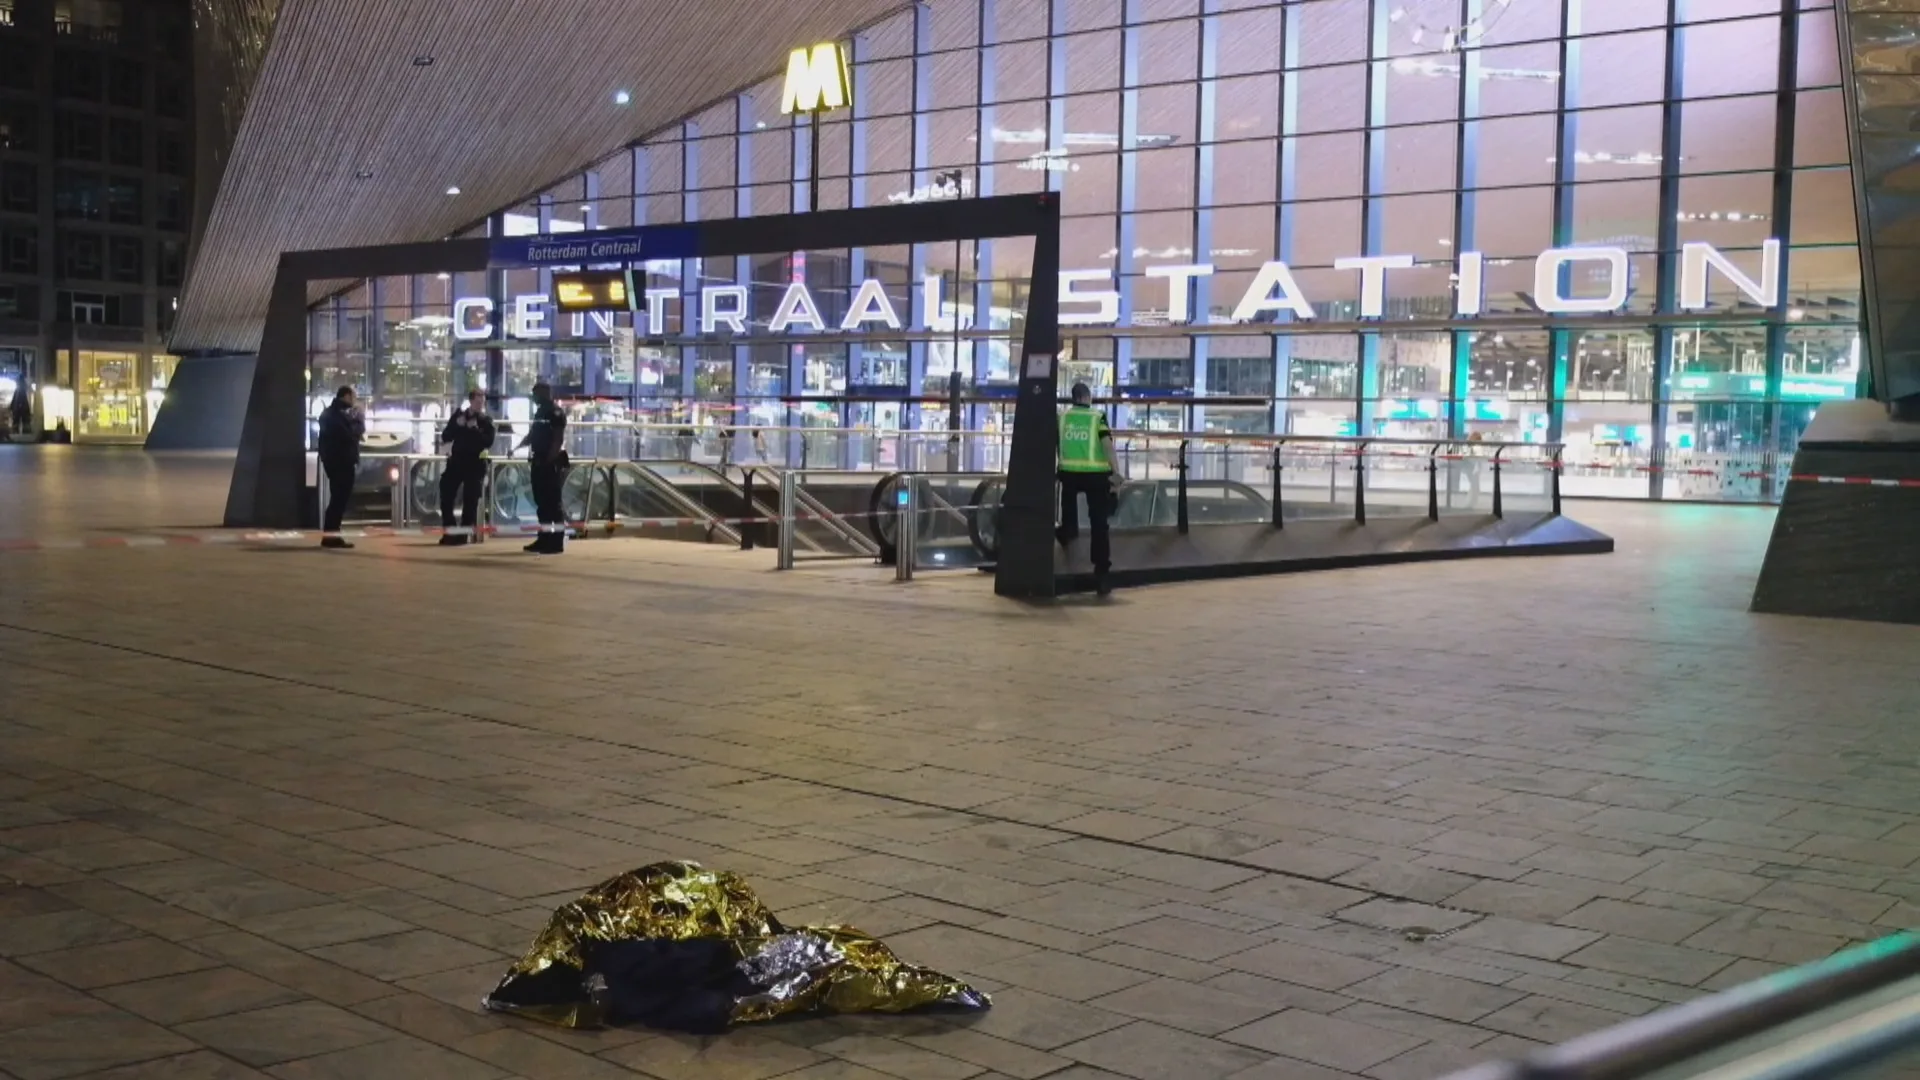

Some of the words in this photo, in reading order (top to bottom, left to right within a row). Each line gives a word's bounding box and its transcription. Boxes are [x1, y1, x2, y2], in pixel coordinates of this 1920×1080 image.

[781, 42, 851, 114] M
[528, 245, 587, 261] Rotterdam
[590, 238, 641, 256] Centraal
[453, 274, 974, 340] CENTRAAL
[1058, 238, 1782, 324] STATION
